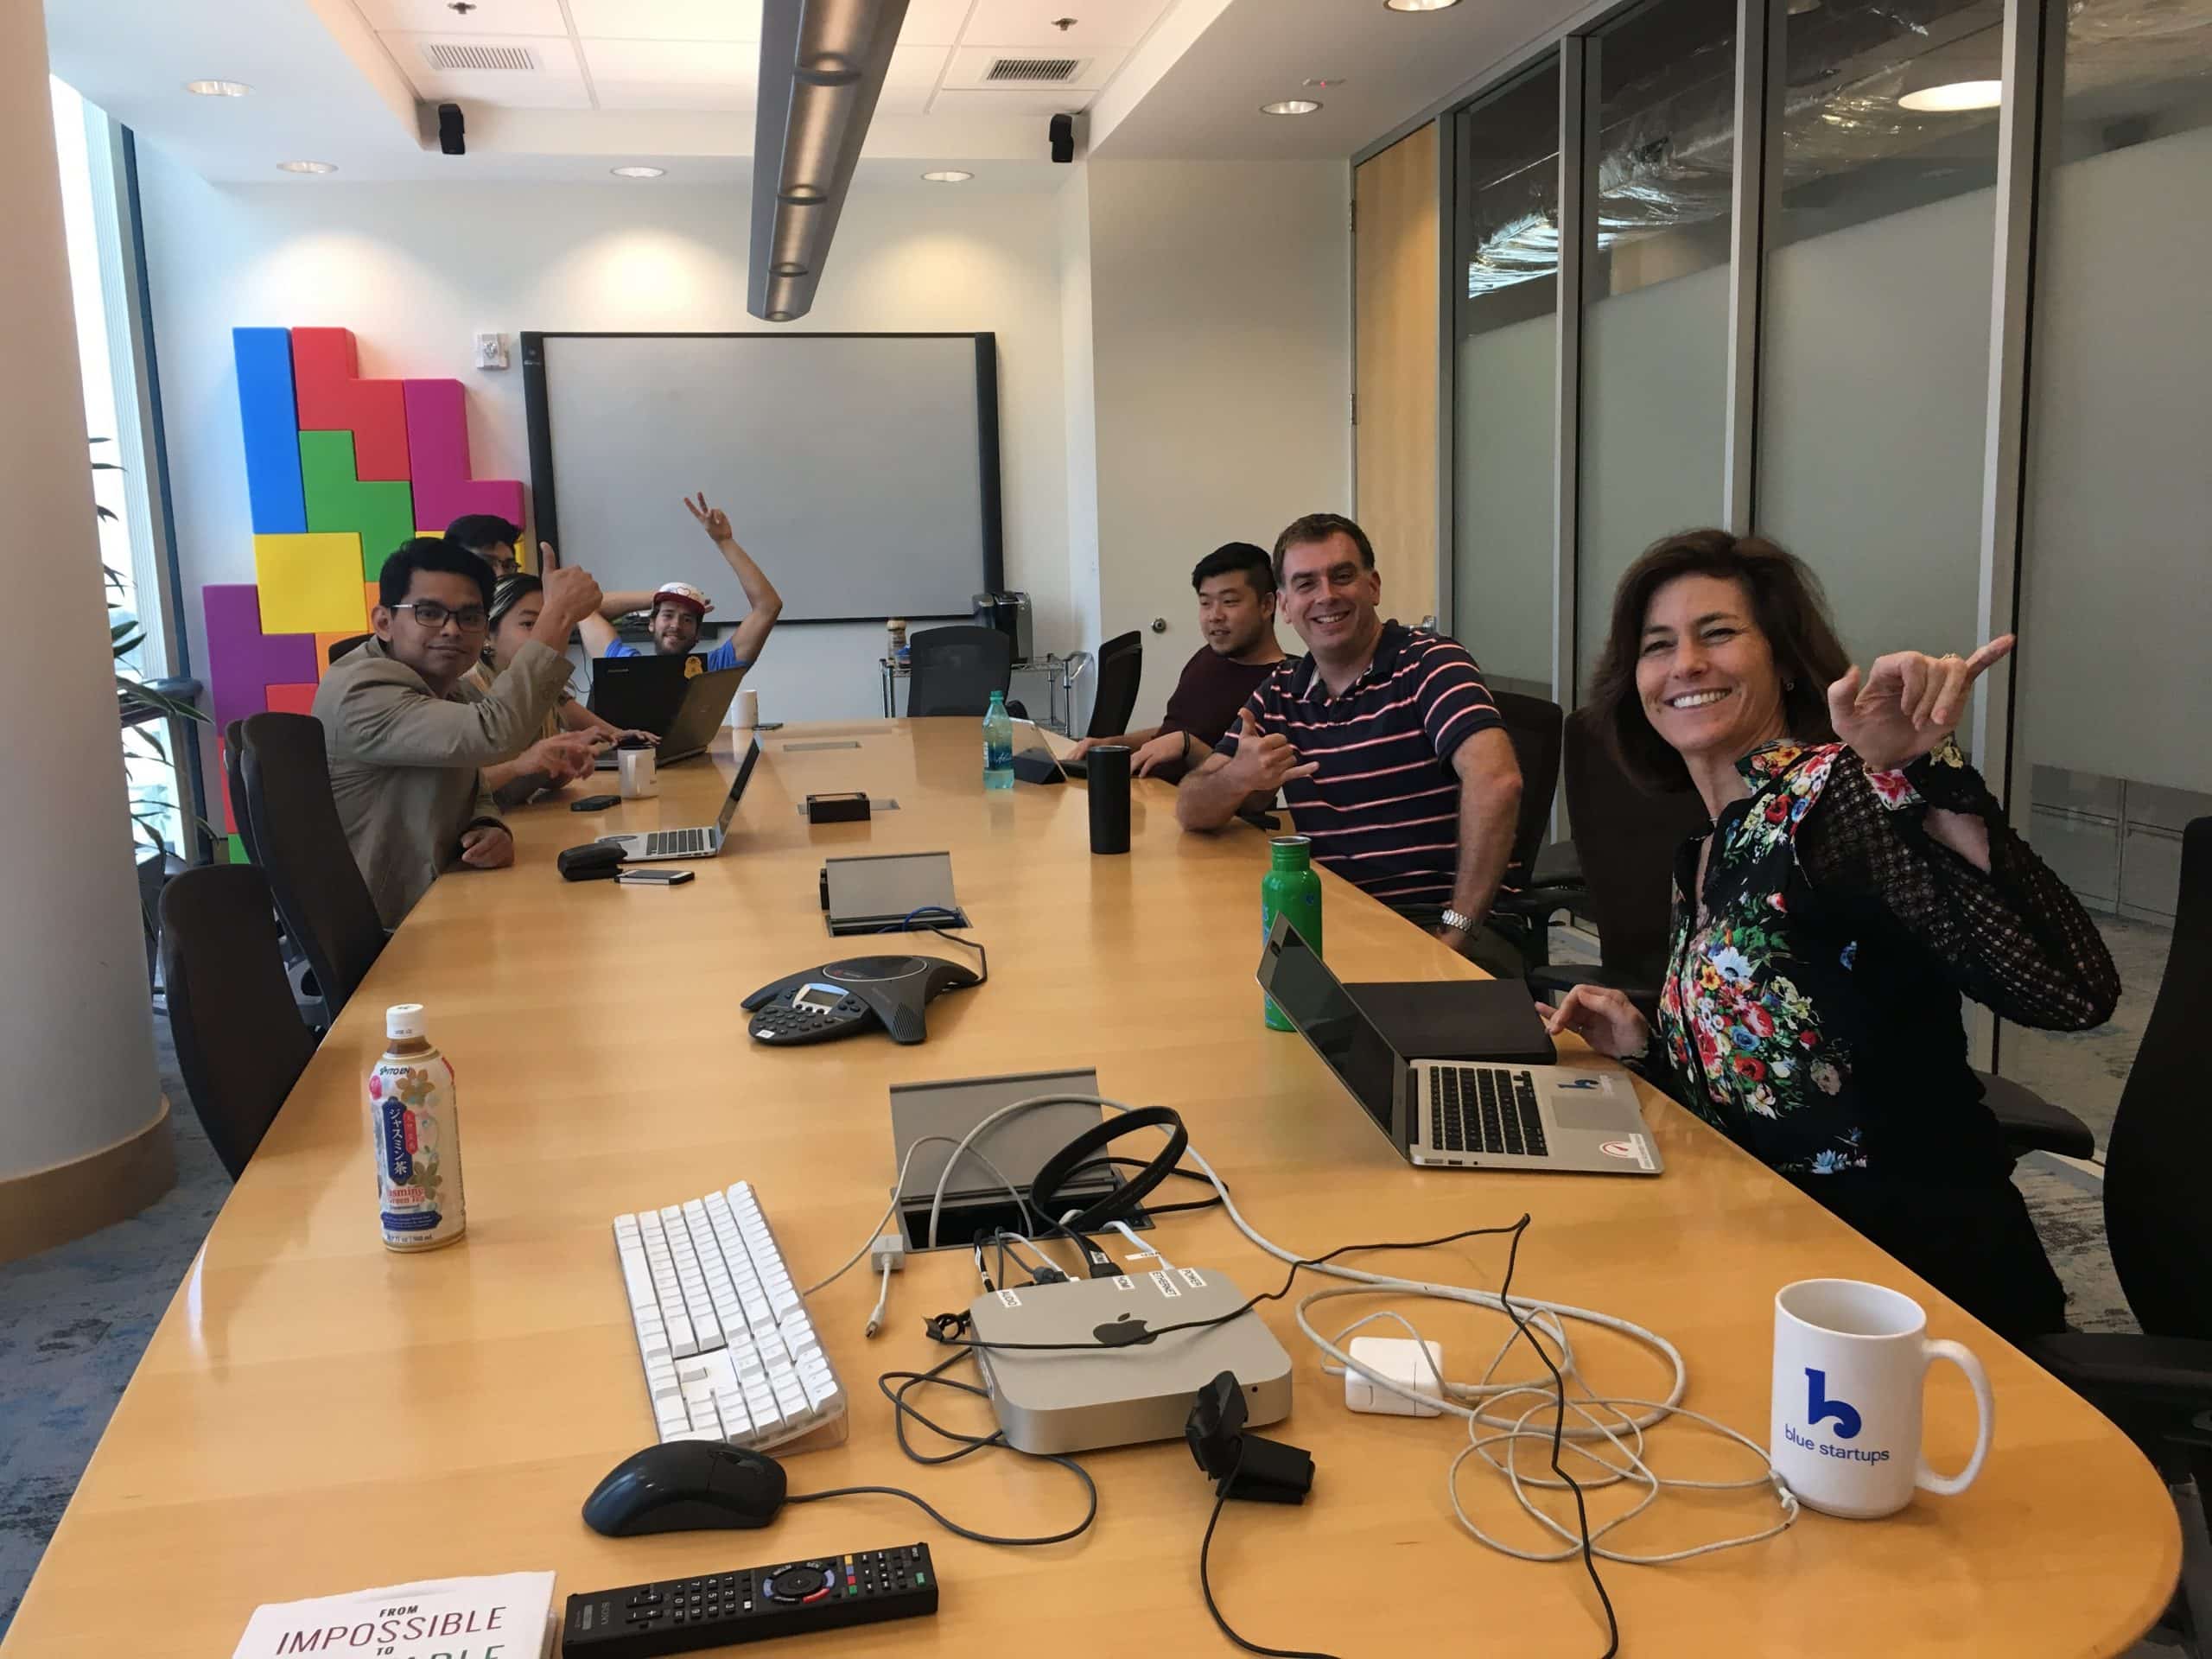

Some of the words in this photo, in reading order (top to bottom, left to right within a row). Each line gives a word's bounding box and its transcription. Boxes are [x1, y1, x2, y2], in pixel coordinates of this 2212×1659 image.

[389, 1109, 407, 1175] ジャスミン茶
[1152, 1271, 1177, 1295] ETHERNET
[1181, 1269, 1203, 1287] POWER
[1784, 1423, 1815, 1451] blue
[1819, 1442, 1891, 1466] startups
[379, 1605, 418, 1618] FROM
[276, 1606, 507, 1656] IMPOSSIBLE
[377, 1646, 395, 1656] TO
